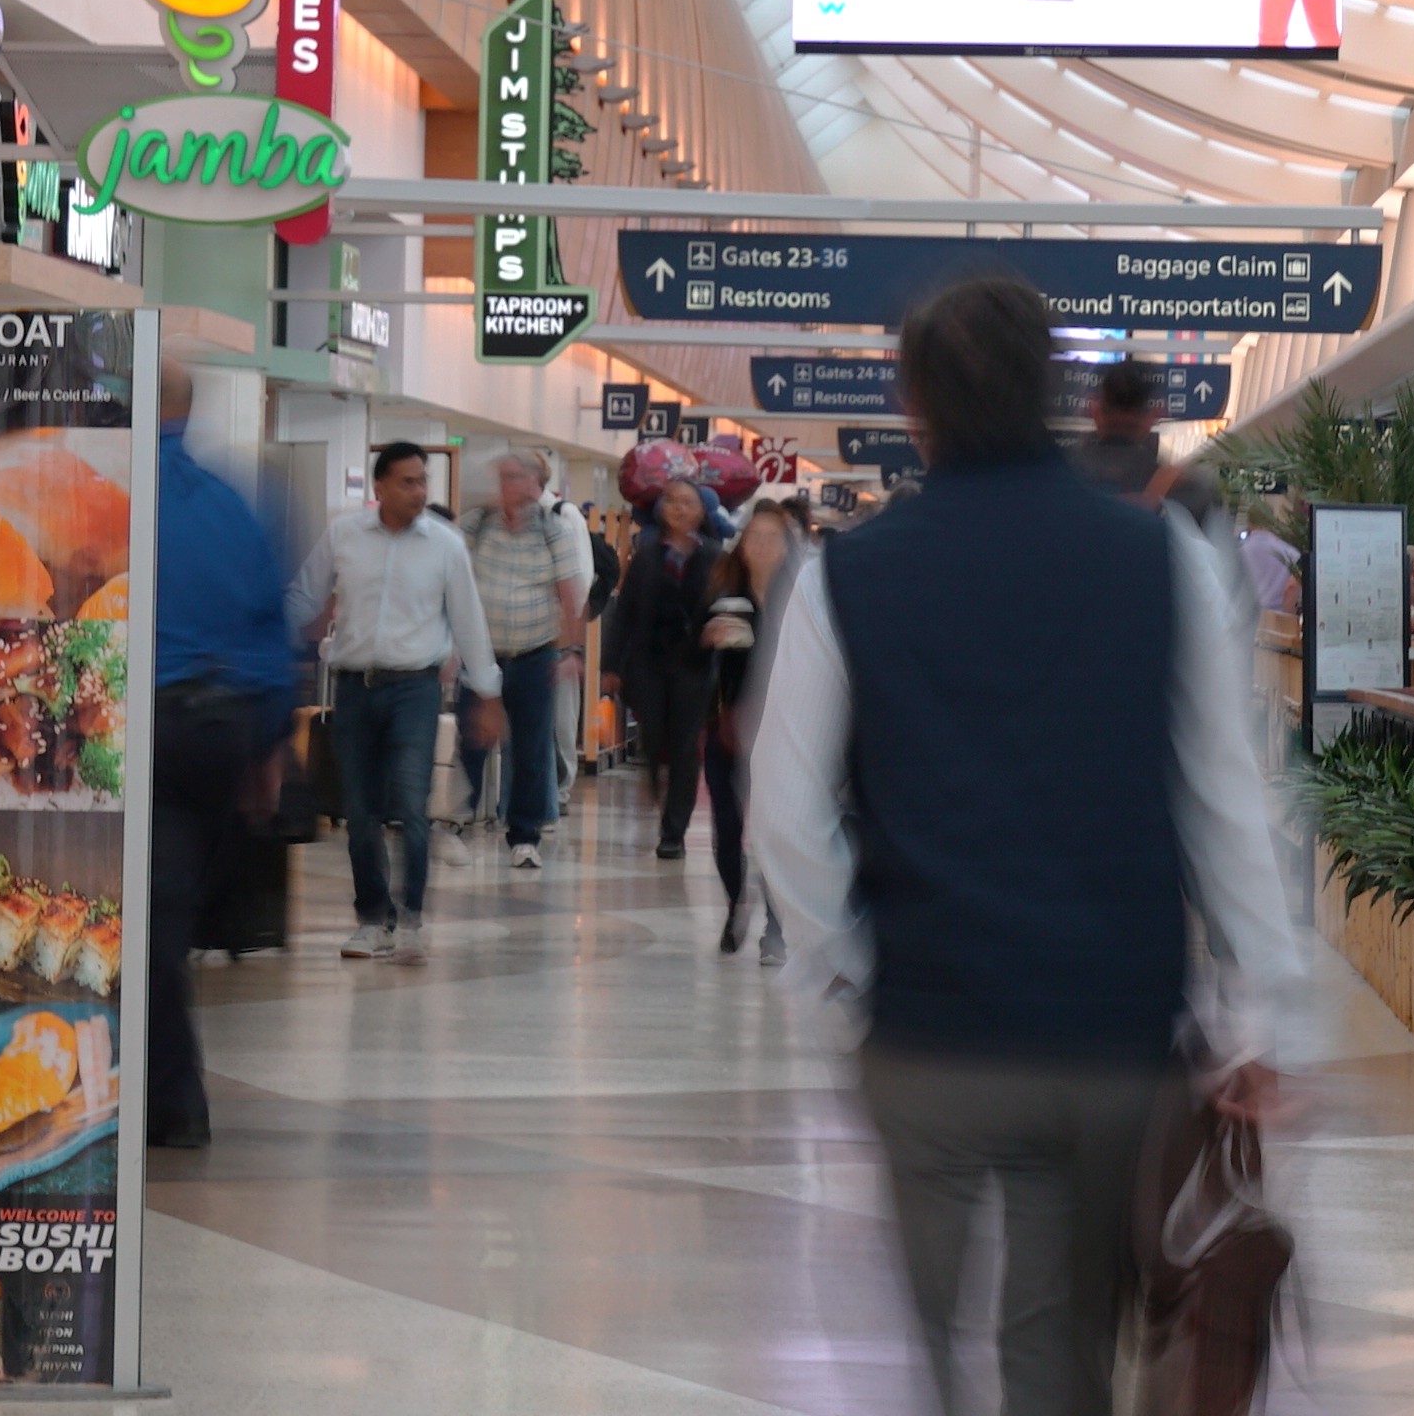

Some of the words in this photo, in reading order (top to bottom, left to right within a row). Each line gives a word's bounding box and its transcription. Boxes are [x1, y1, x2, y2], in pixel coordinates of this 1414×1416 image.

[500, 18, 529, 101] JIM
[72, 101, 343, 216] jamba
[721, 245, 782, 268] Gates
[787, 247, 849, 269] 23-36
[1117, 254, 1211, 280] Baggage
[1217, 255, 1277, 277] Claim
[720, 286, 832, 309] Restrooms
[1118, 294, 1277, 320] Transportation
[485, 316, 565, 335] KITCHEN
[815, 366, 854, 381] Gates
[13, 389, 41, 402] Beer
[42, 390, 52, 402] &
[53, 389, 80, 403] Cold
[814, 391, 885, 406] Restrooms
[0, 1208, 85, 1223] WELCOME
[93, 1210, 116, 1223] TO
